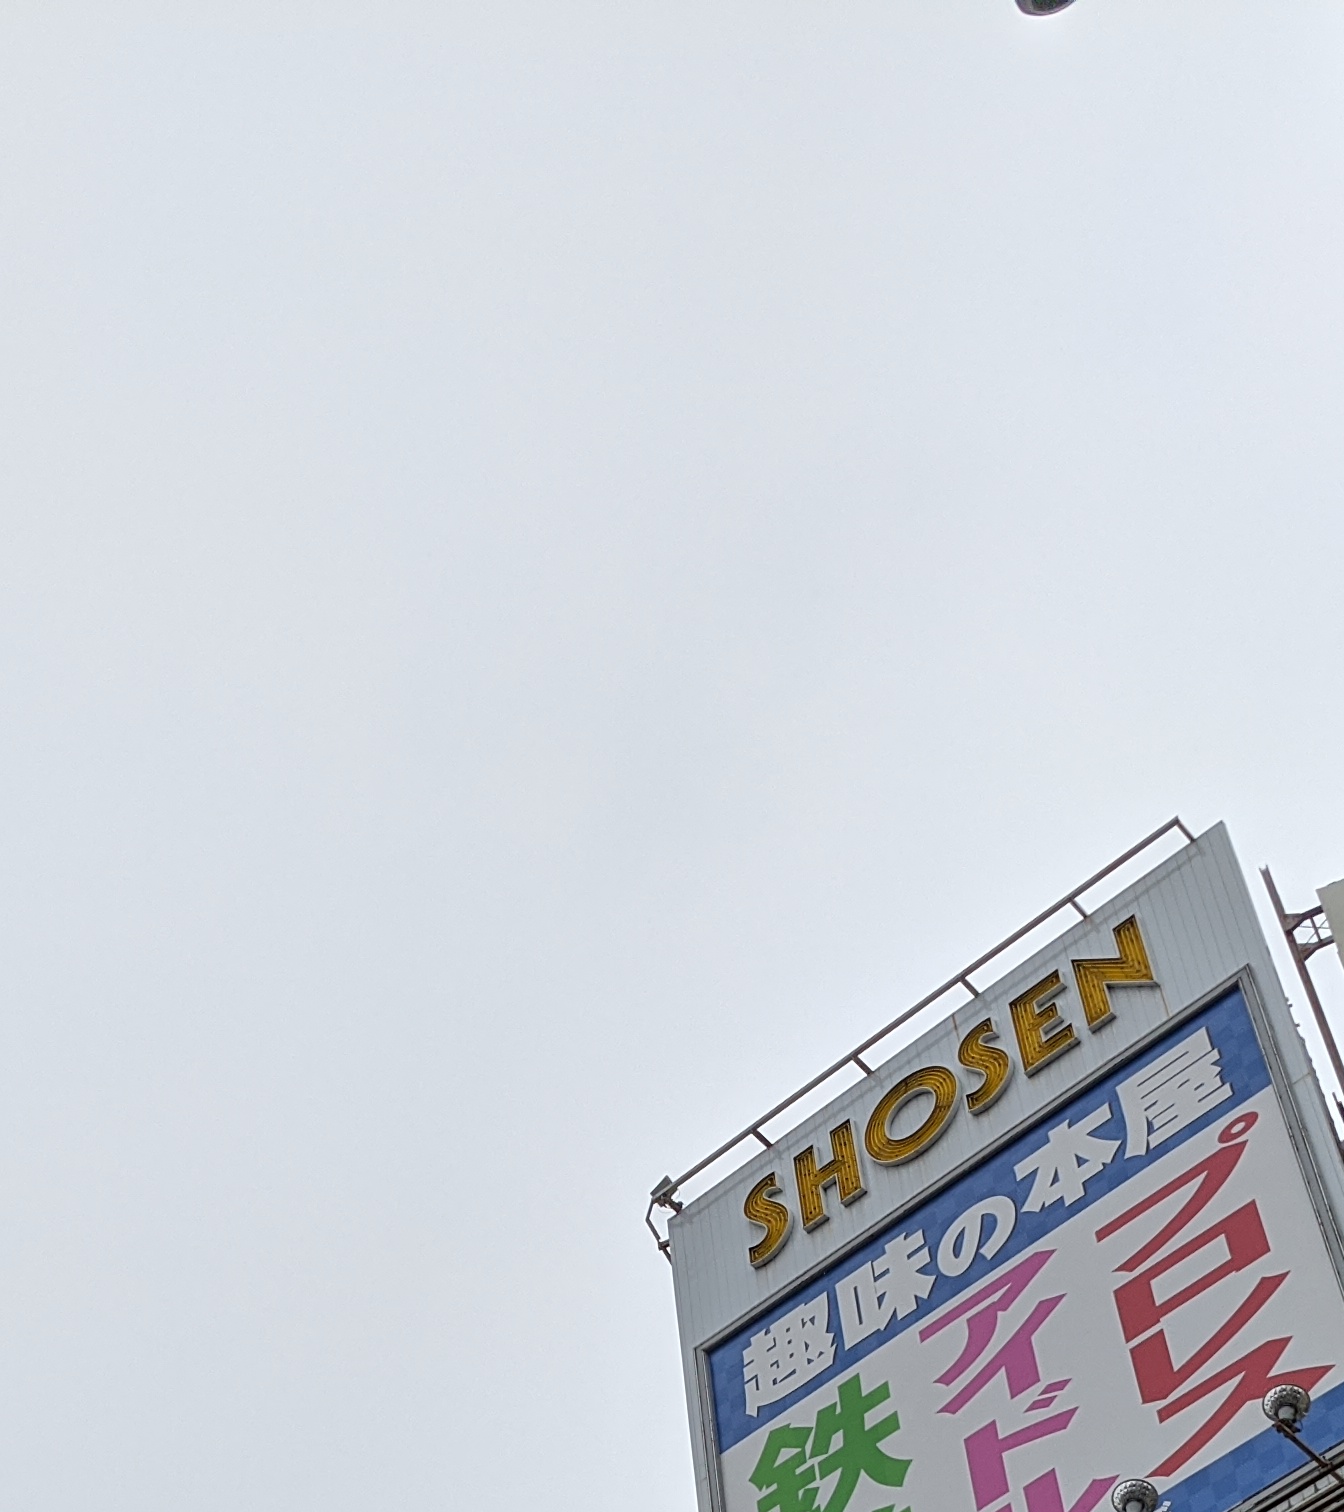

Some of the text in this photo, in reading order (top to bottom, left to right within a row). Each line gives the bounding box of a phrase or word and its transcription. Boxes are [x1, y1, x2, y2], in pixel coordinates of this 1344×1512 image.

[743, 914, 1160, 1269] SHOSEN
[743, 1026, 1233, 1418] 趣味の本屋
[1095, 1110, 1335, 1477] プロレス
